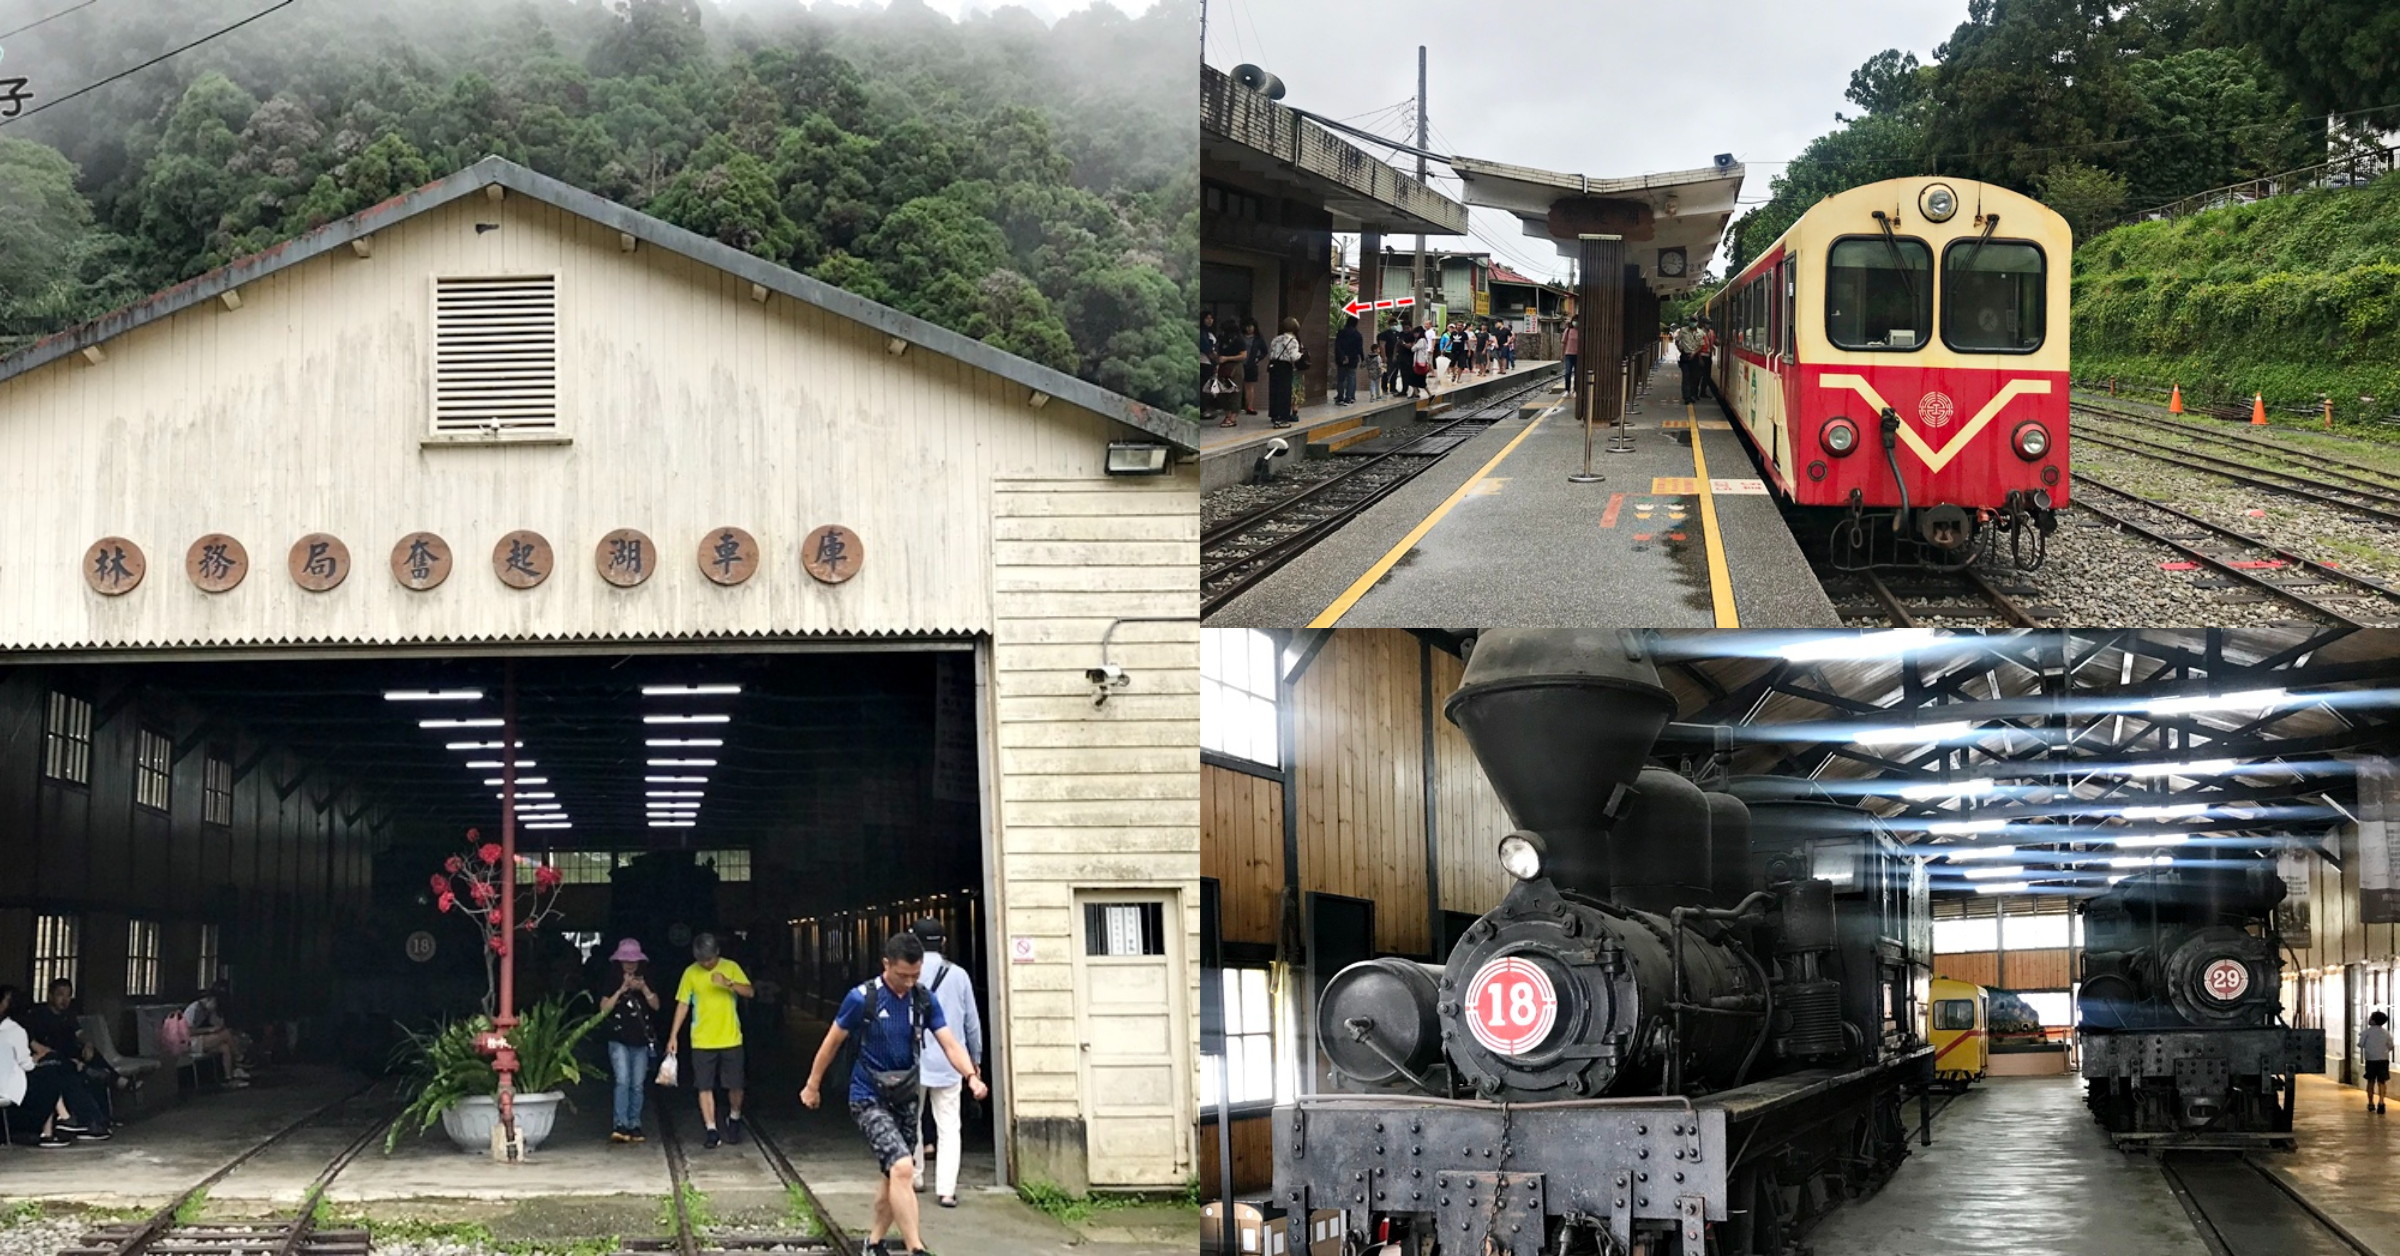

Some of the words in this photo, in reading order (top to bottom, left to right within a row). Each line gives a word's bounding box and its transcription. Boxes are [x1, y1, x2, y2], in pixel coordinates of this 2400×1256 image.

[94, 531, 849, 586] 林務局奮起湖車庫
[413, 939, 430, 953] 18
[2213, 969, 2240, 989] 29
[1487, 981, 1537, 1026] 18
